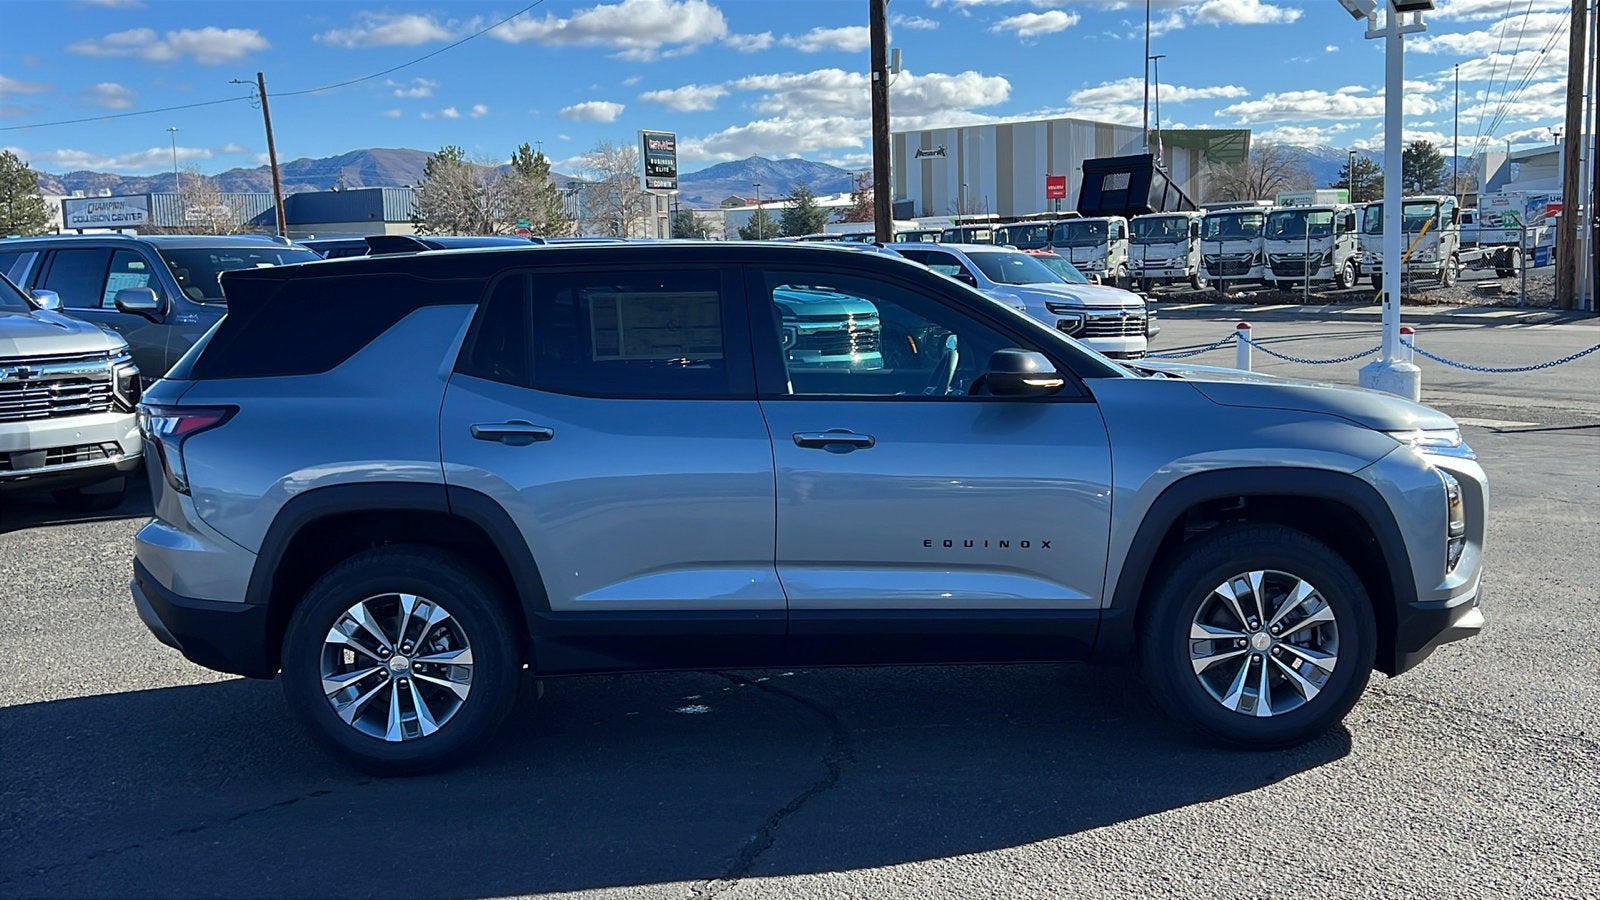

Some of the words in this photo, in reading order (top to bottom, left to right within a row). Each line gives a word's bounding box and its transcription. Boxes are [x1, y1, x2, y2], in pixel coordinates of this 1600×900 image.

[648, 139, 675, 151] GMC
[88, 201, 126, 214] CHAMPION
[72, 214, 110, 224] COLLISION
[111, 212, 143, 222] CENTER
[923, 539, 1051, 548] EQUINOX
